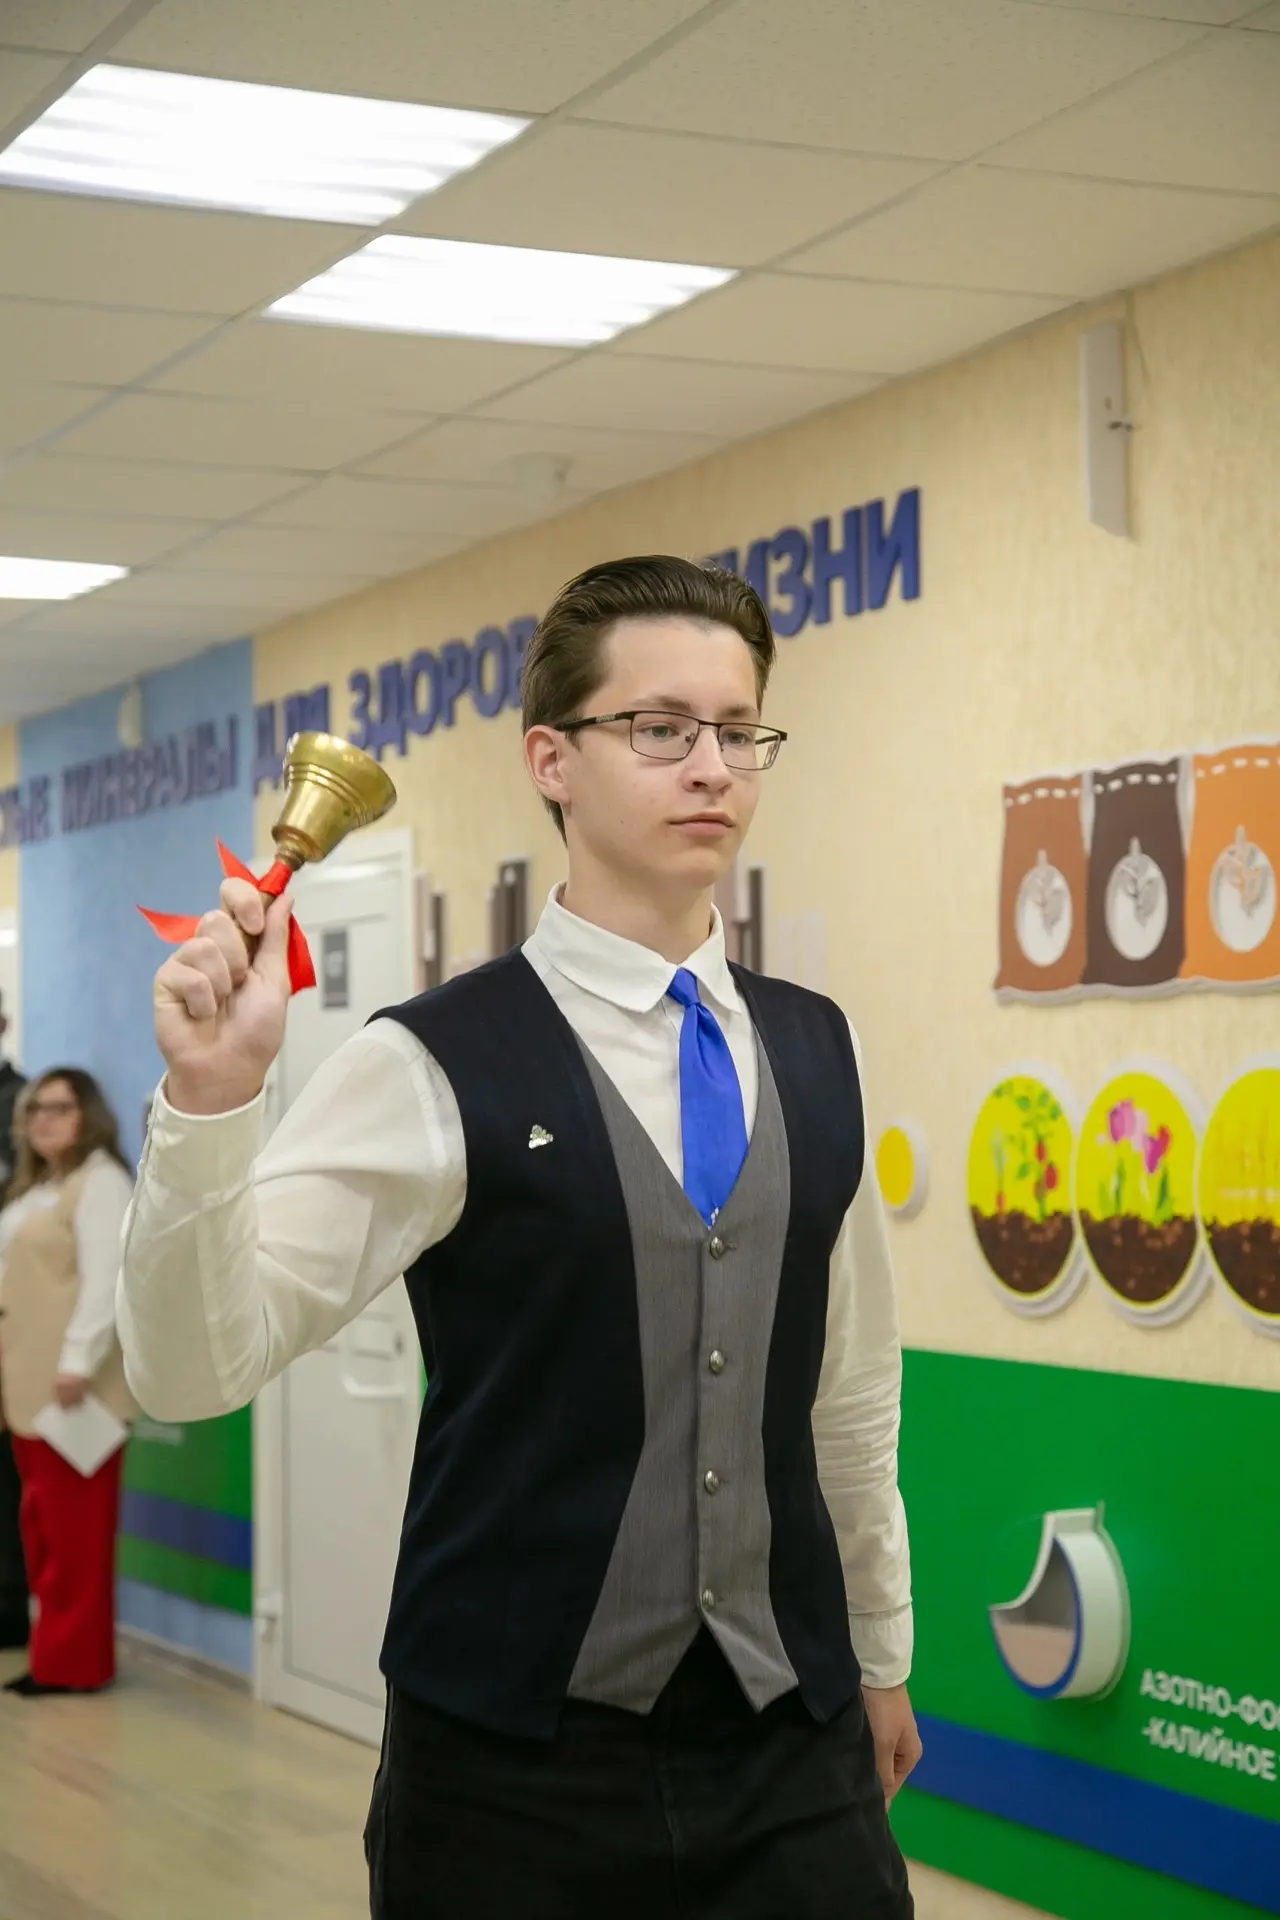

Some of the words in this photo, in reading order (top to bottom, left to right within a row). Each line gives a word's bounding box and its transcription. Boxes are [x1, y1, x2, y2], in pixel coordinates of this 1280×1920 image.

[347, 614, 539, 762] ЗДОРОВ
[703, 485, 921, 637] ИЗНИ
[1140, 1667, 1280, 1732] АЗОТНО-ФО
